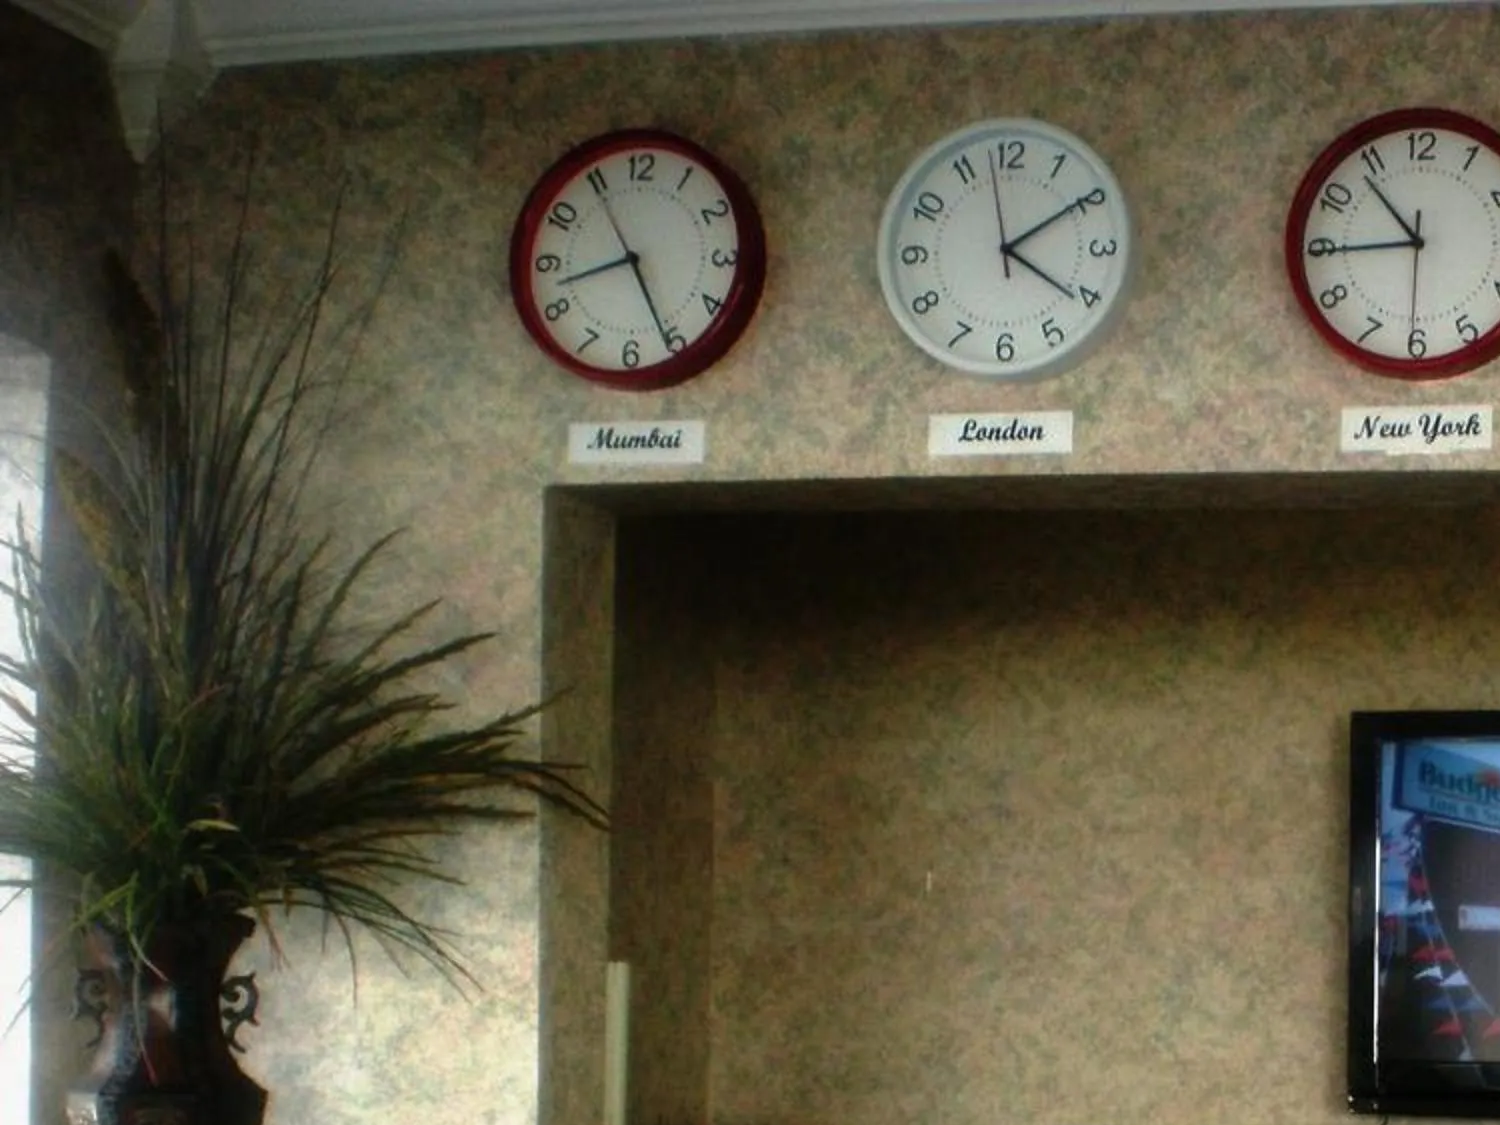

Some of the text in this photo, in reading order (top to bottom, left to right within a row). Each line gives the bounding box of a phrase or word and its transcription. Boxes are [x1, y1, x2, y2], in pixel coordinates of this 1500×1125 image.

[997, 140, 1025, 170] 12
[1407, 131, 1437, 161] 12
[1462, 145, 1481, 172] 1
[628, 154, 655, 181] 12
[952, 154, 977, 185] 11
[1050, 153, 1066, 179] 1
[1360, 145, 1386, 176] 11
[586, 167, 609, 195] 11
[677, 165, 694, 191] 1
[912, 191, 945, 223] 10
[1077, 187, 1106, 215] 2
[1321, 182, 1352, 214] 10
[547, 201, 578, 231] 10
[701, 200, 729, 226] 2
[711, 249, 738, 268] 3
[901, 245, 929, 266] 9
[1089, 239, 1118, 257] 3
[1307, 237, 1337, 257] 9
[535, 254, 561, 273] 9
[545, 297, 570, 321] 8
[701, 293, 725, 316] 4
[912, 290, 940, 315] 8
[1078, 285, 1102, 309] 4
[1319, 284, 1348, 309] 8
[576, 328, 600, 354] 7
[665, 326, 687, 355] 5
[948, 320, 973, 349] 7
[1041, 318, 1065, 348] 5
[1356, 316, 1384, 344] 7
[1455, 314, 1479, 346] 5
[622, 340, 640, 369] 6
[995, 333, 1015, 362] 6
[1407, 329, 1427, 360] 6
[587, 427, 684, 450] Mumbai
[957, 418, 1045, 443] London
[1353, 412, 1482, 444] New York
